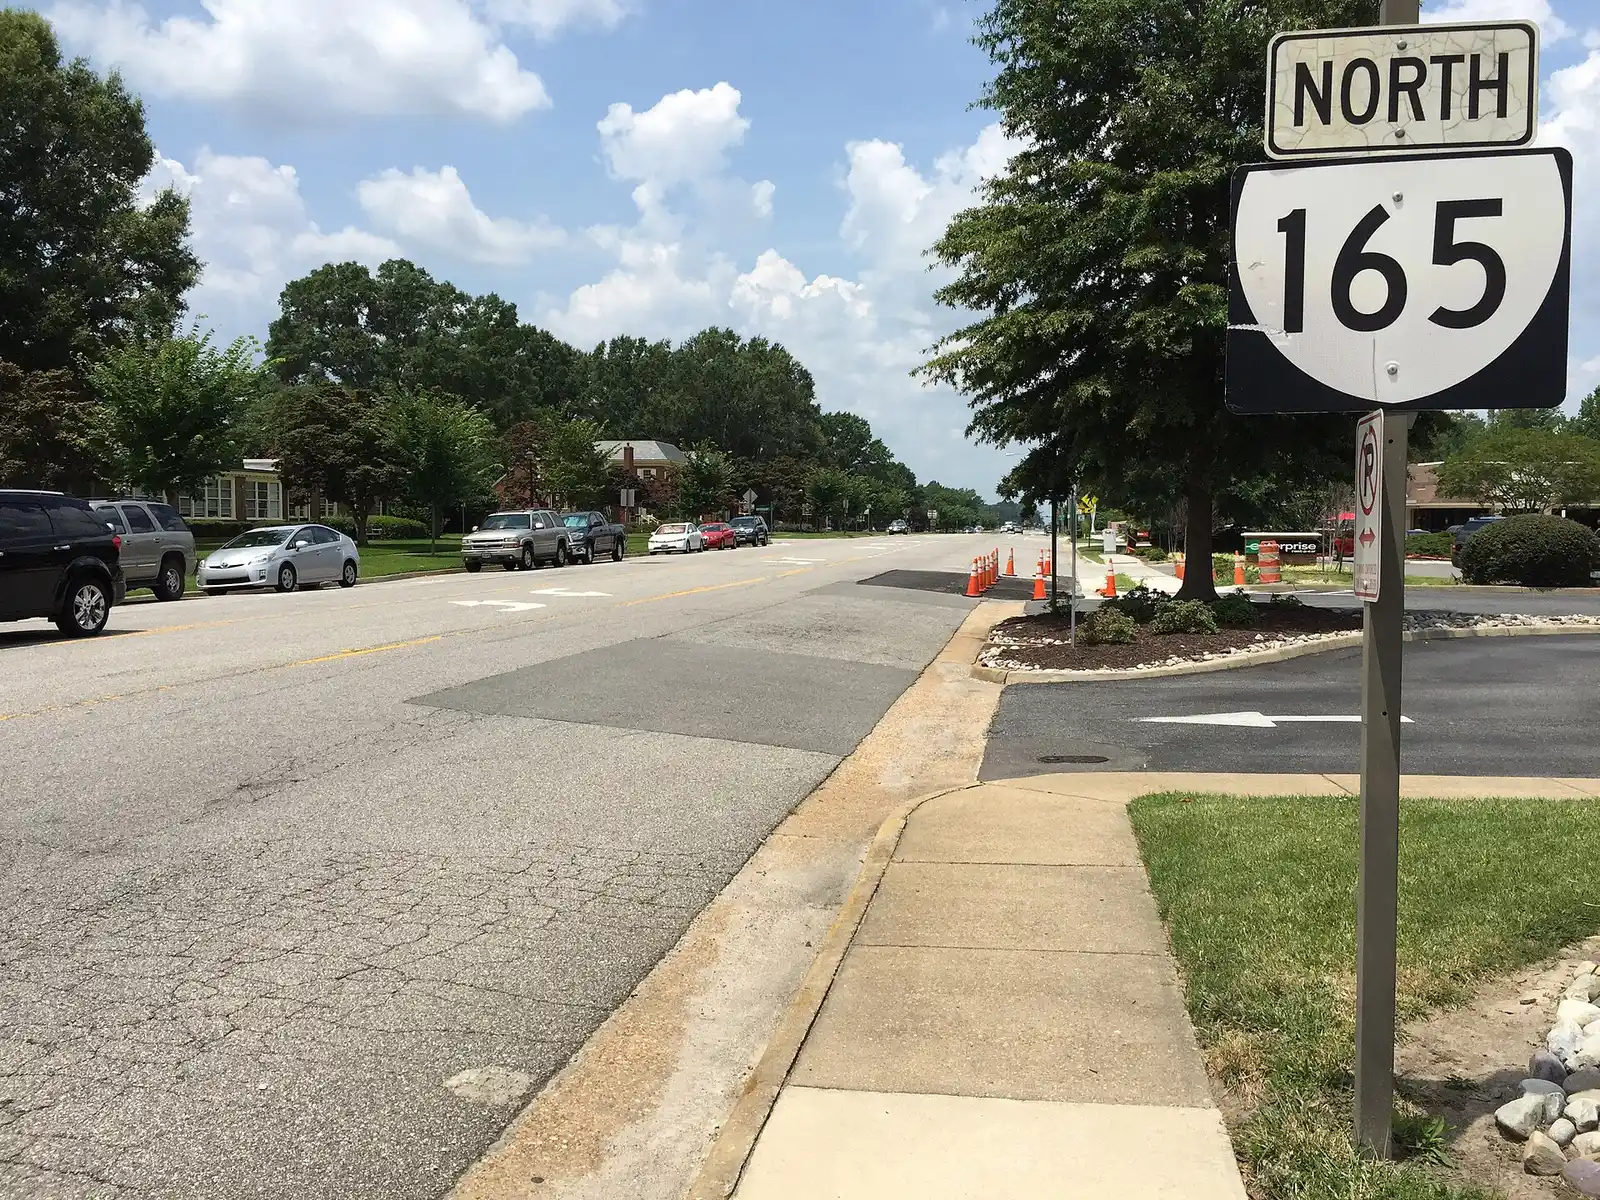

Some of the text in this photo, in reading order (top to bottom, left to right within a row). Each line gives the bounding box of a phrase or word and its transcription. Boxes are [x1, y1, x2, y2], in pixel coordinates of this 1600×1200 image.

[1293, 52, 1509, 127] NORTH
[1277, 197, 1507, 334] 165
[1247, 542, 1317, 552] erprise
